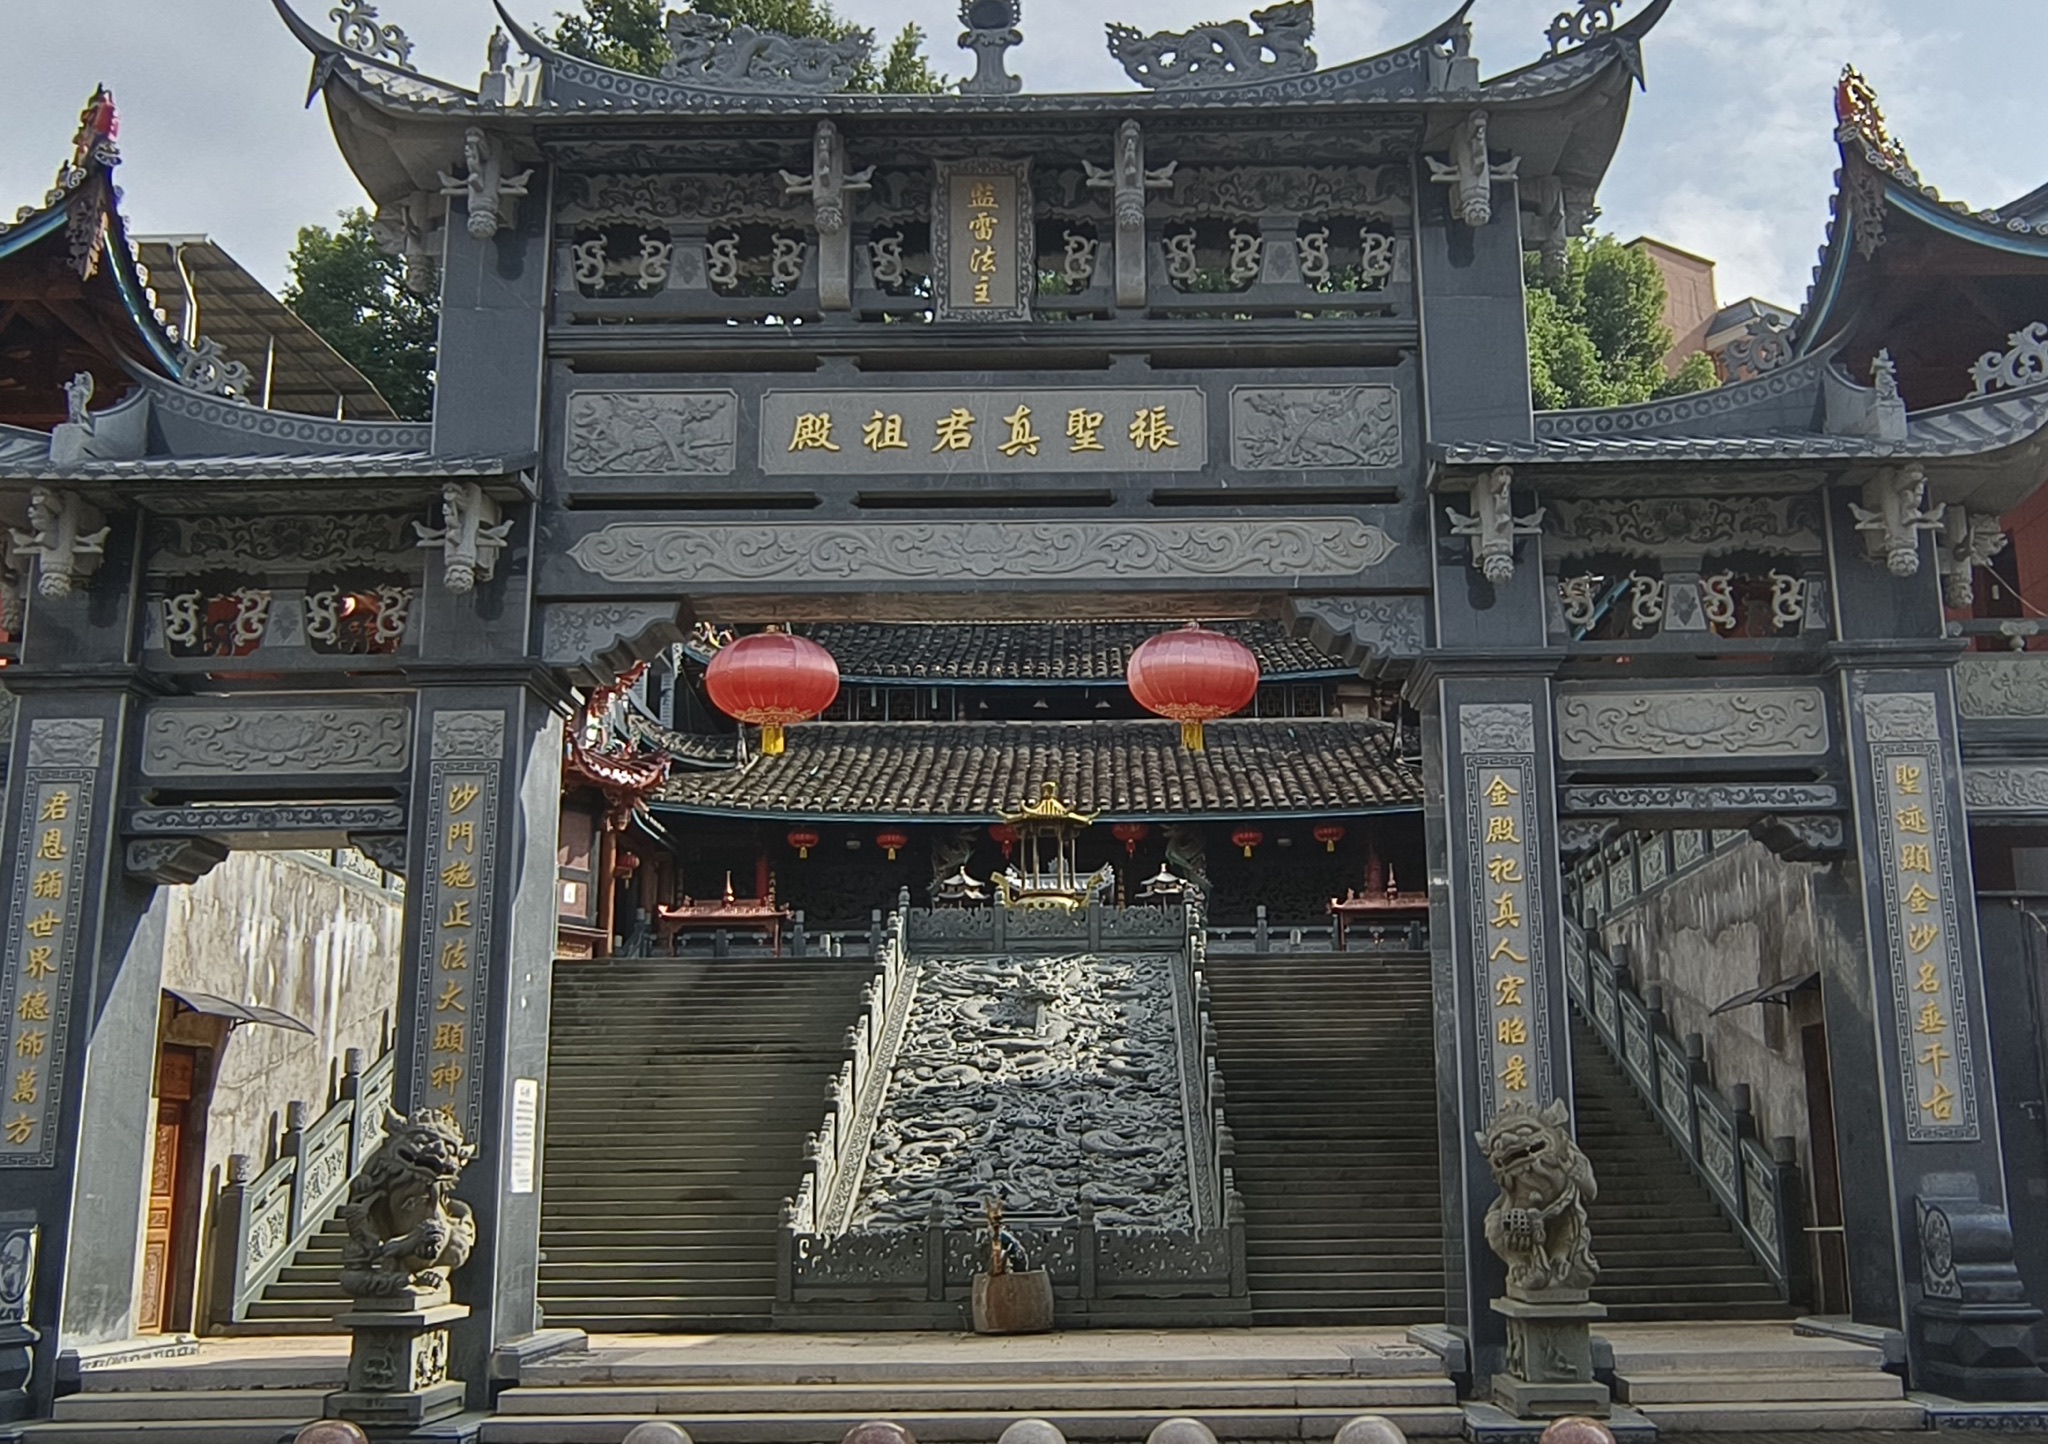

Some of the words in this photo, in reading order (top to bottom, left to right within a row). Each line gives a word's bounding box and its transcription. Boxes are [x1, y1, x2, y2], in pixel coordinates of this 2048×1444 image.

[430, 785, 480, 1117] 沙門施正法大顯神
[1483, 774, 1528, 1098] 金殿祀真人宏昭景
